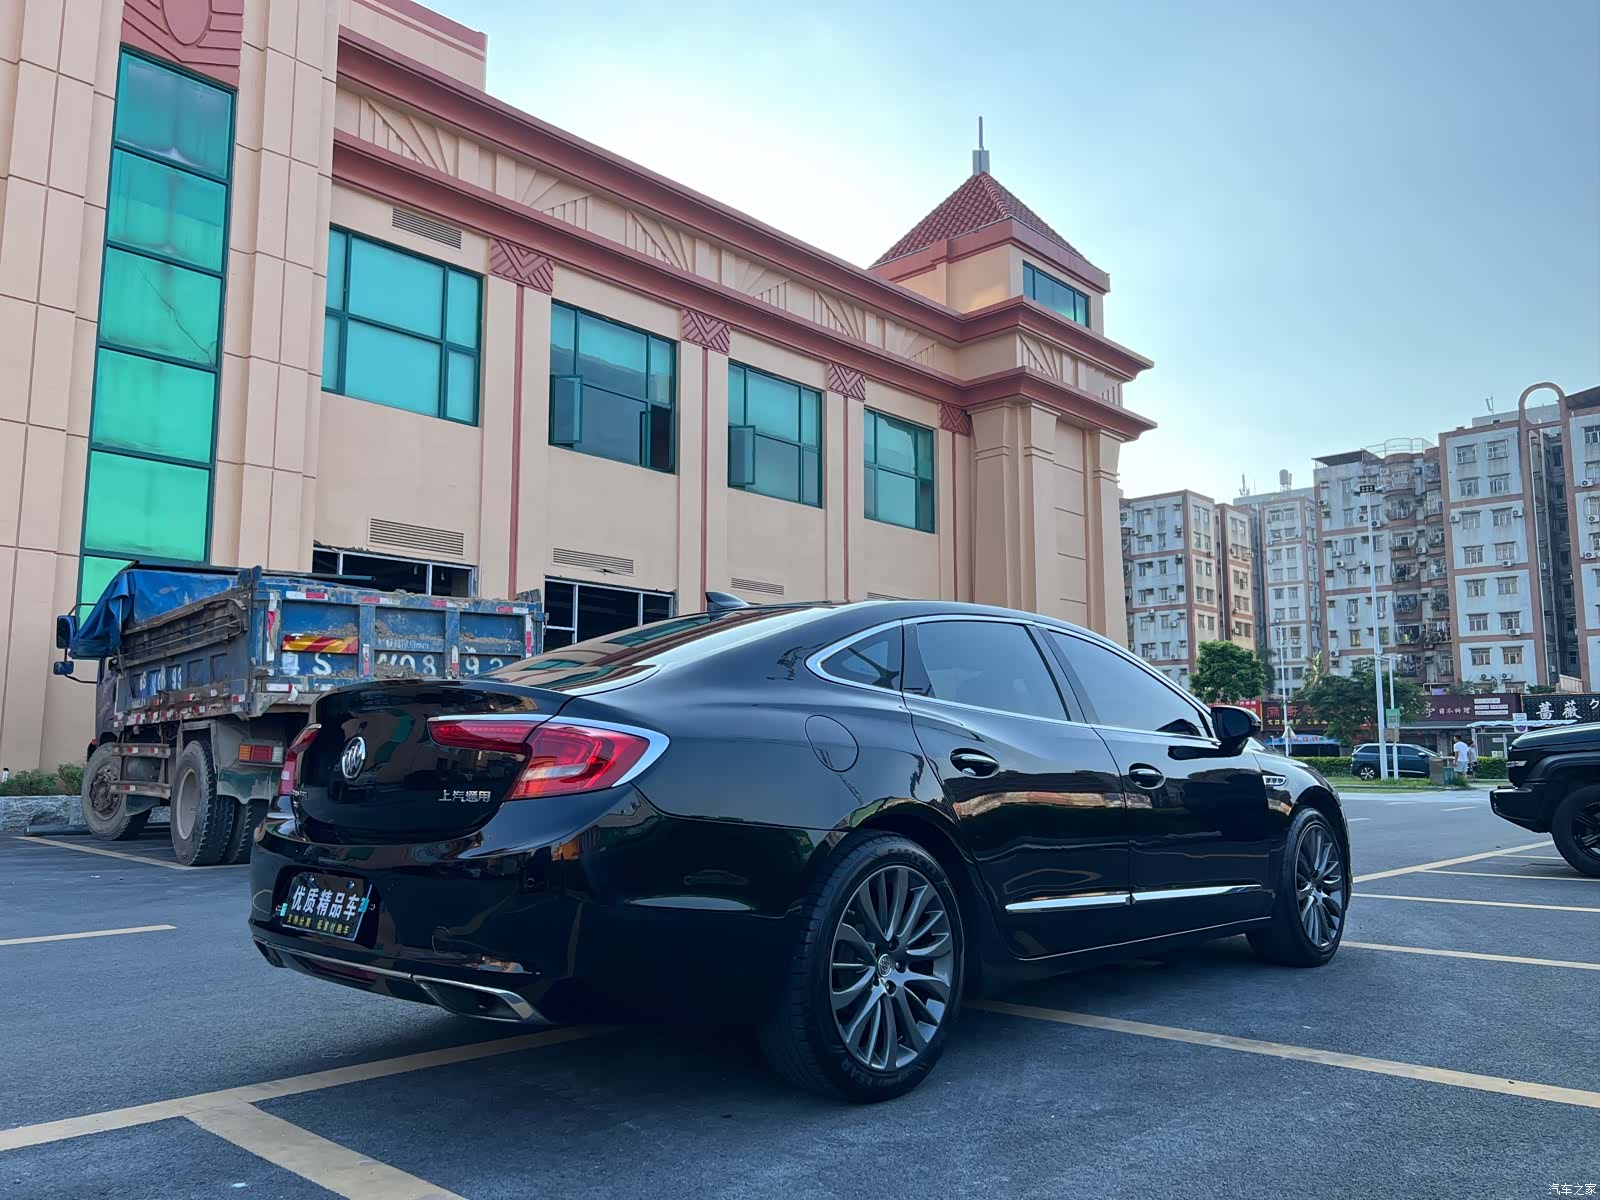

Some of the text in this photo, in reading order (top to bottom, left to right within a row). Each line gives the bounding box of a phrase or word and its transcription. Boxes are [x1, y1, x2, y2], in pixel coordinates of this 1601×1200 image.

[438, 789, 492, 803] 上汽通用
[291, 885, 360, 921] 优质精品车
